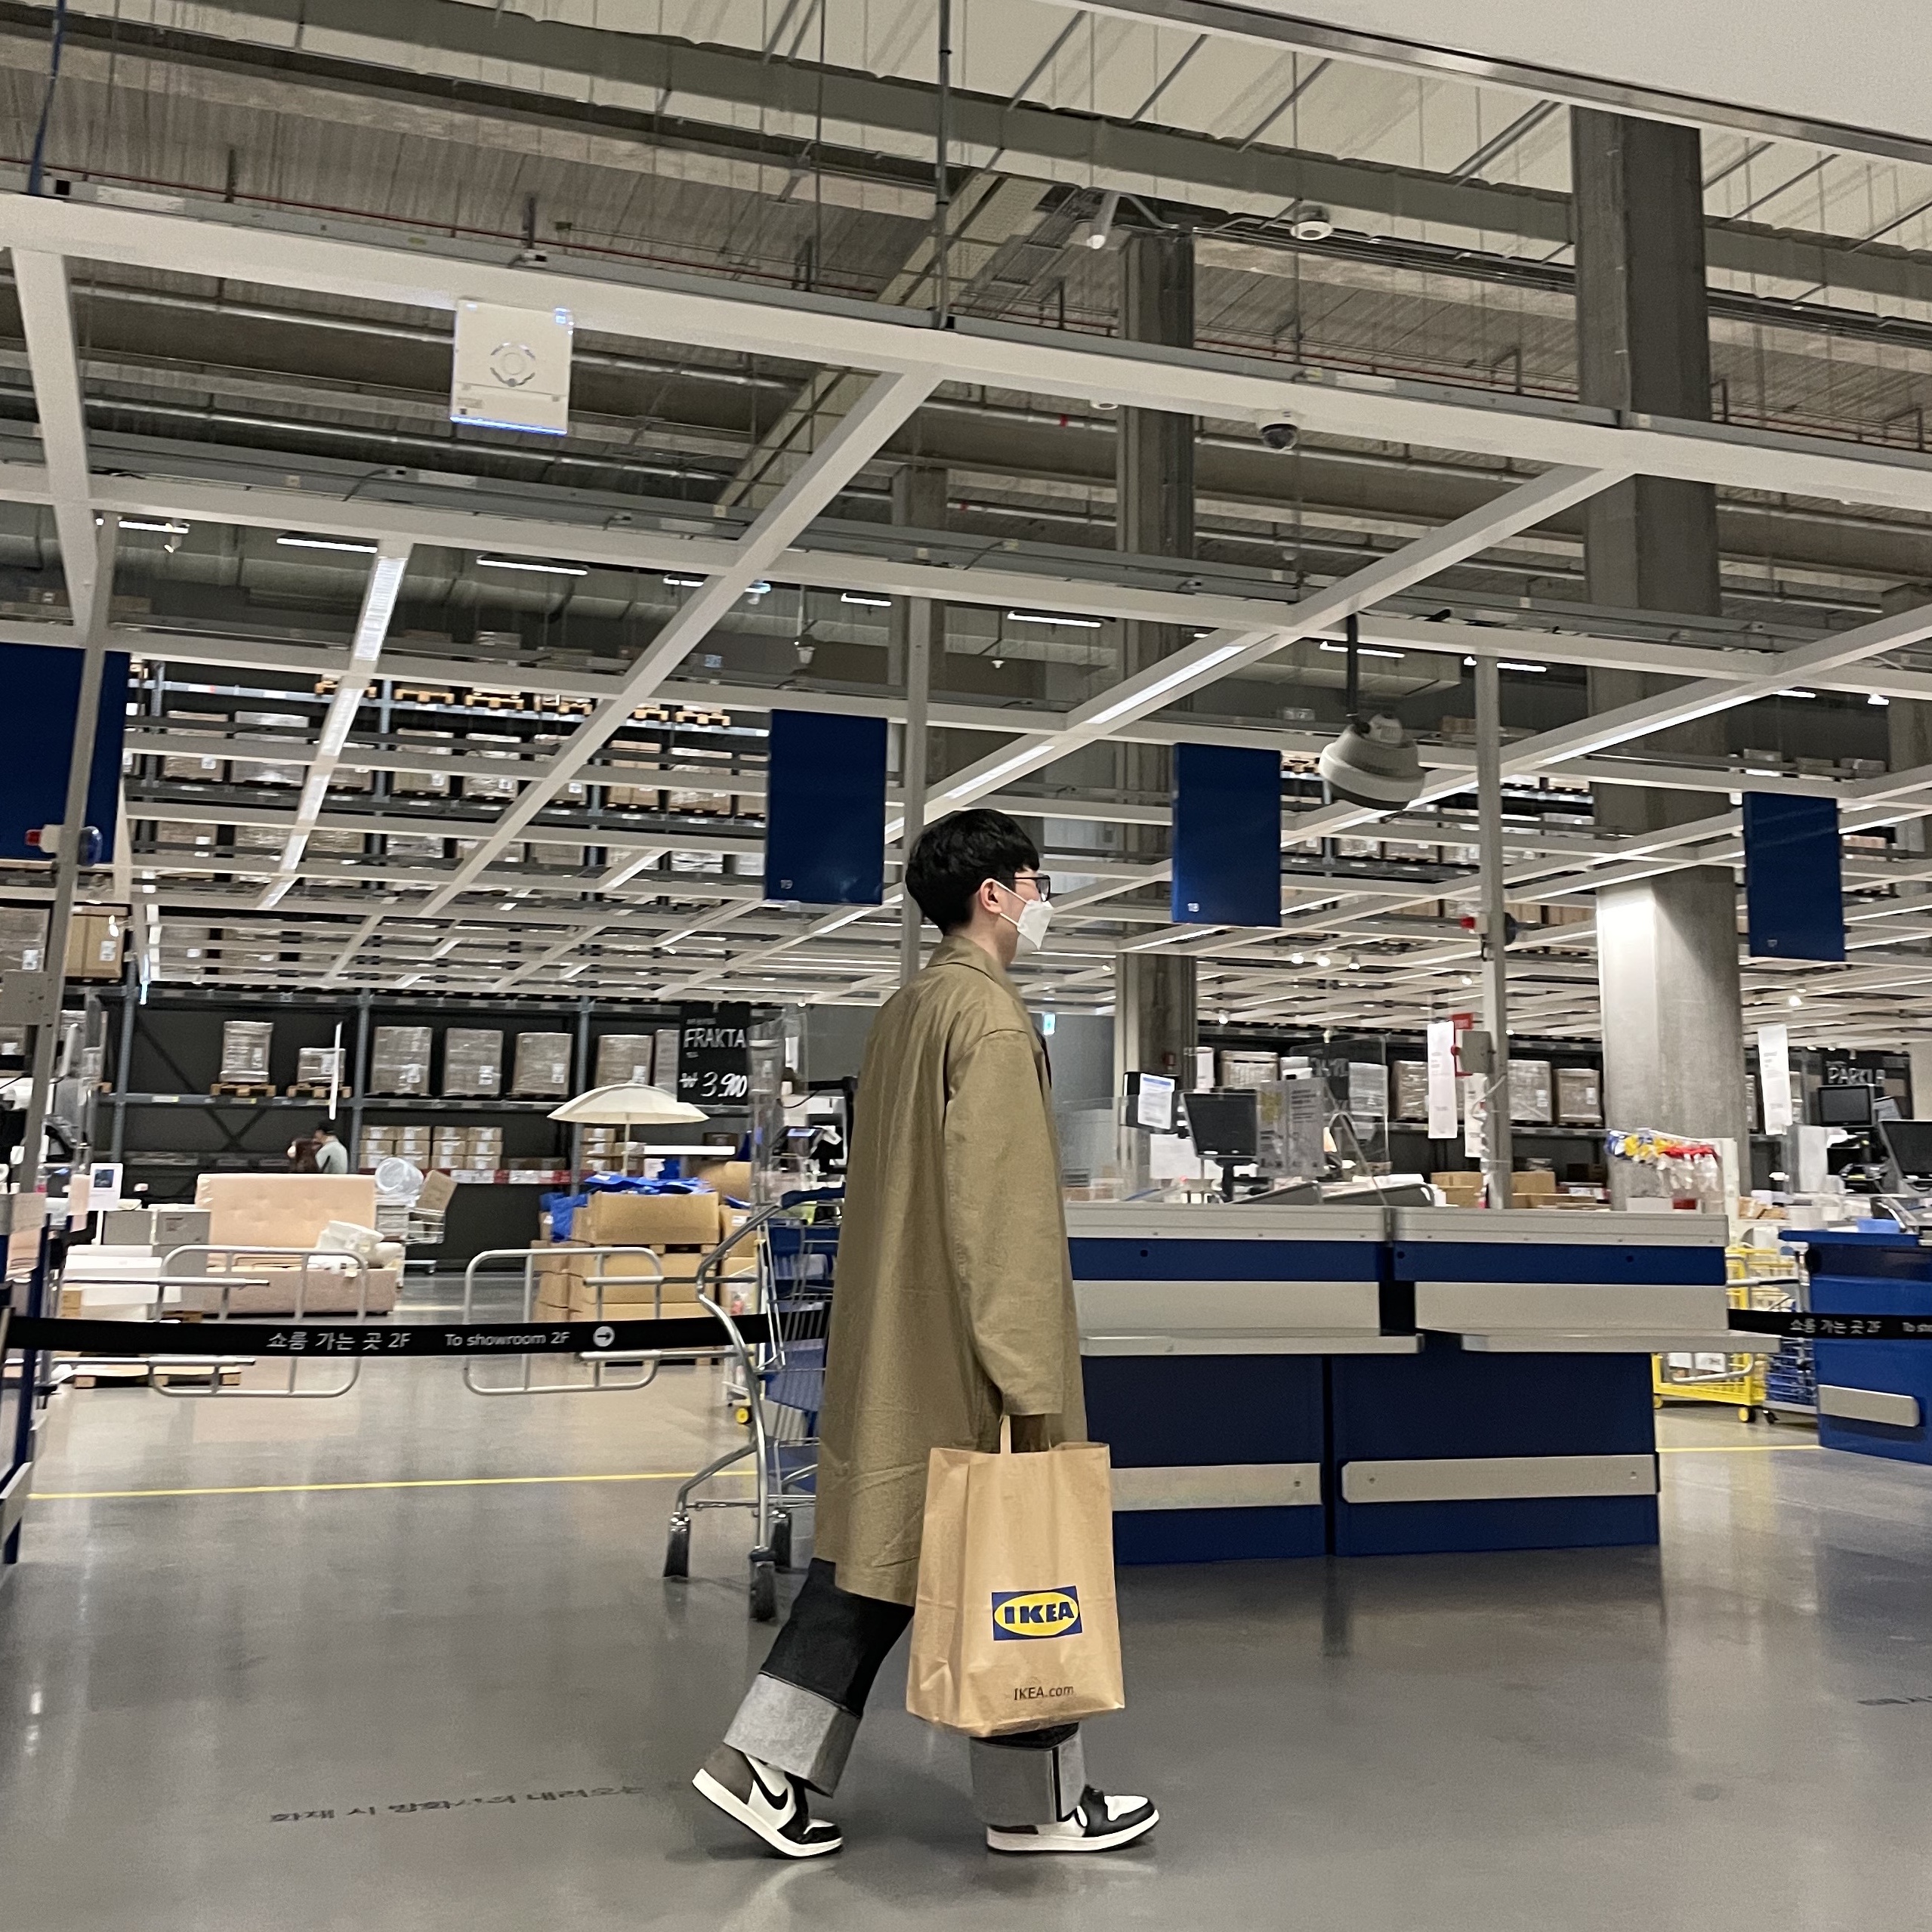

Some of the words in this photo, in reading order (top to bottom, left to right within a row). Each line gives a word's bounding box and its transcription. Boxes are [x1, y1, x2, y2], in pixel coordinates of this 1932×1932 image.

[684, 1028, 748, 1048] FRAKTA
[266, 1331, 309, 1350] 쇼룸
[315, 1332, 356, 1350] 가는
[362, 1332, 384, 1350] 곳
[387, 1332, 412, 1348] 2F
[444, 1333, 464, 1347] To
[466, 1333, 547, 1347] showroom
[551, 1331, 571, 1344] 2F
[1005, 1601, 1075, 1625] IKEA
[1014, 1686, 1074, 1701] IKEA.com
